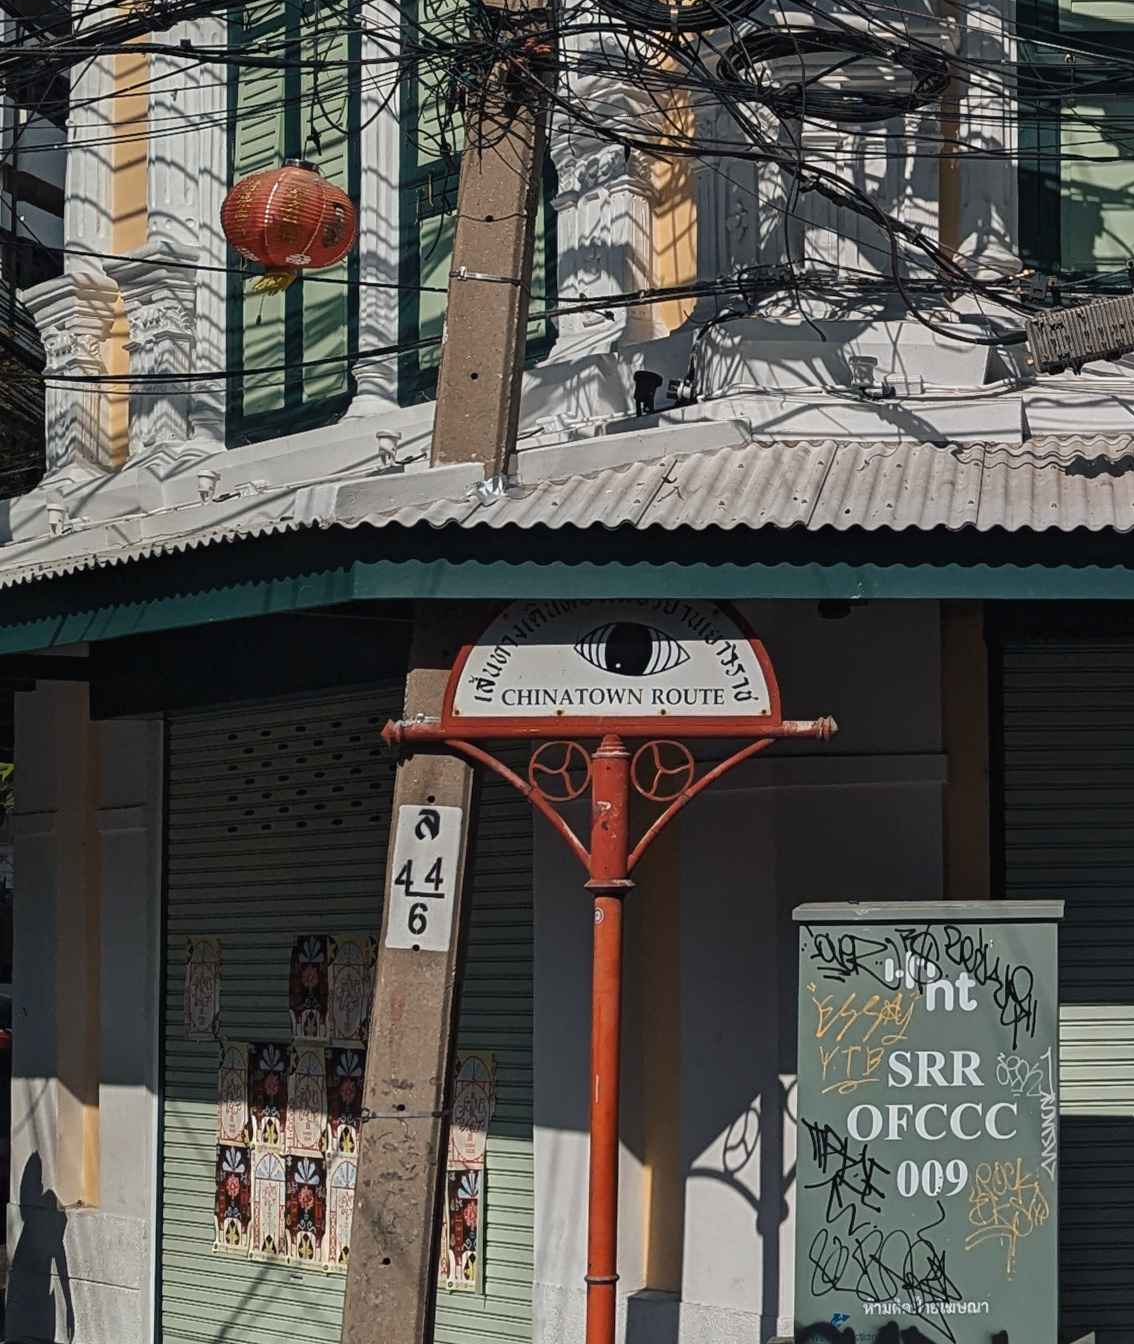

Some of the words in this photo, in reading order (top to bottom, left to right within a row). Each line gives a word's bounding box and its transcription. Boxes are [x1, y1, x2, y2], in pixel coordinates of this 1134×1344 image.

[501, 688, 643, 705] CHINATOWN
[651, 688, 725, 705] ROUTE
[408, 902, 428, 935] 6
[925, 971, 979, 1012] nt
[888, 1050, 984, 1087] SRR
[847, 1103, 1018, 1141] OFCCC
[896, 1159, 968, 1198] 009
